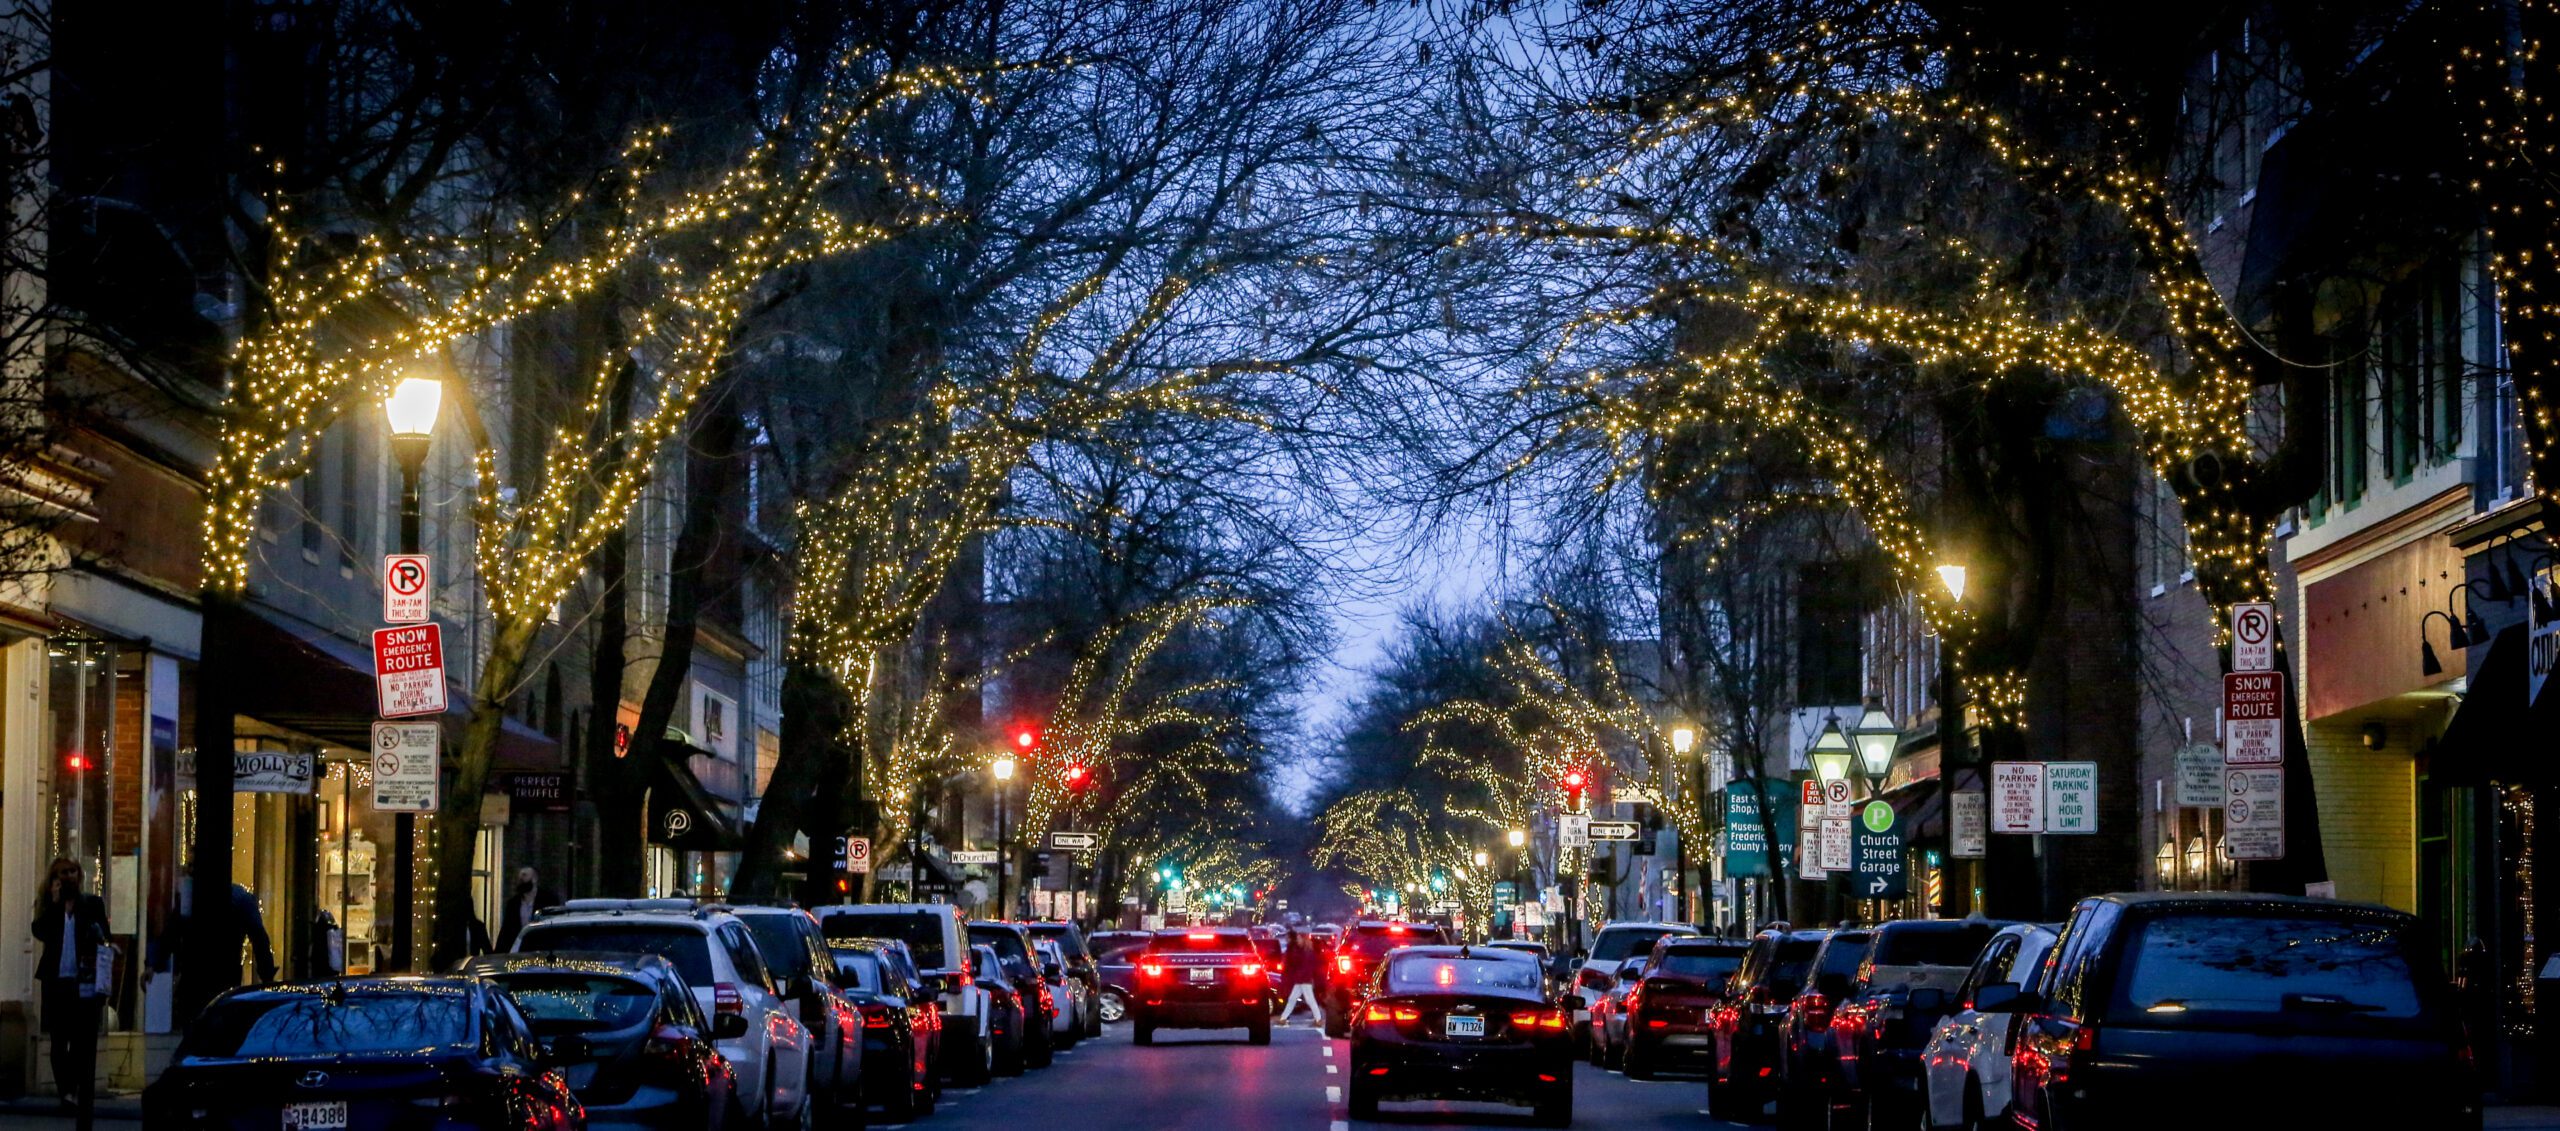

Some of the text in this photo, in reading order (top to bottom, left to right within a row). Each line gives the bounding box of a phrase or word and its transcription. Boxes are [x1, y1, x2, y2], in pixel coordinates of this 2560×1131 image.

[392, 609, 422, 617] THIS SIDE
[386, 629, 427, 646] SNOW
[383, 642, 432, 657] EMERGENCY
[385, 653, 433, 671] ROUTE
[2240, 657, 2266, 666] THIS SIDE
[390, 680, 433, 692] NO PARKING
[2235, 677, 2272, 691] SNOW
[400, 688, 425, 700] DURING
[2231, 692, 2276, 702] EMERGENCY
[2232, 703, 2275, 717] ROUTE
[2234, 730, 2273, 738] NO PARKING
[2243, 739, 2265, 748] DURING
[2236, 748, 2271, 757] EMERGENCY
[234, 757, 308, 776] MOLLY'S
[2050, 768, 2091, 779] SATURDAY
[514, 776, 561, 786] PERFECT
[1999, 775, 2038, 783] PARKING
[2052, 781, 2089, 791] PARKING
[516, 788, 560, 798] TRUFFLE
[2062, 793, 2079, 803] ONE
[1731, 794, 1749, 804] East
[2058, 805, 2083, 815] HOUR
[1872, 808, 1887, 825] P
[2060, 818, 2081, 828] LIMIT
[1567, 827, 1582, 835] TURN
[1563, 836, 1586, 844] ON RED
[1731, 832, 1769, 841] Frederic
[1860, 835, 1899, 846] Church
[1731, 842, 1760, 853] County
[960, 853, 988, 862] Church
[1863, 848, 1897, 859] Street
[1860, 862, 1900, 876] Garage
